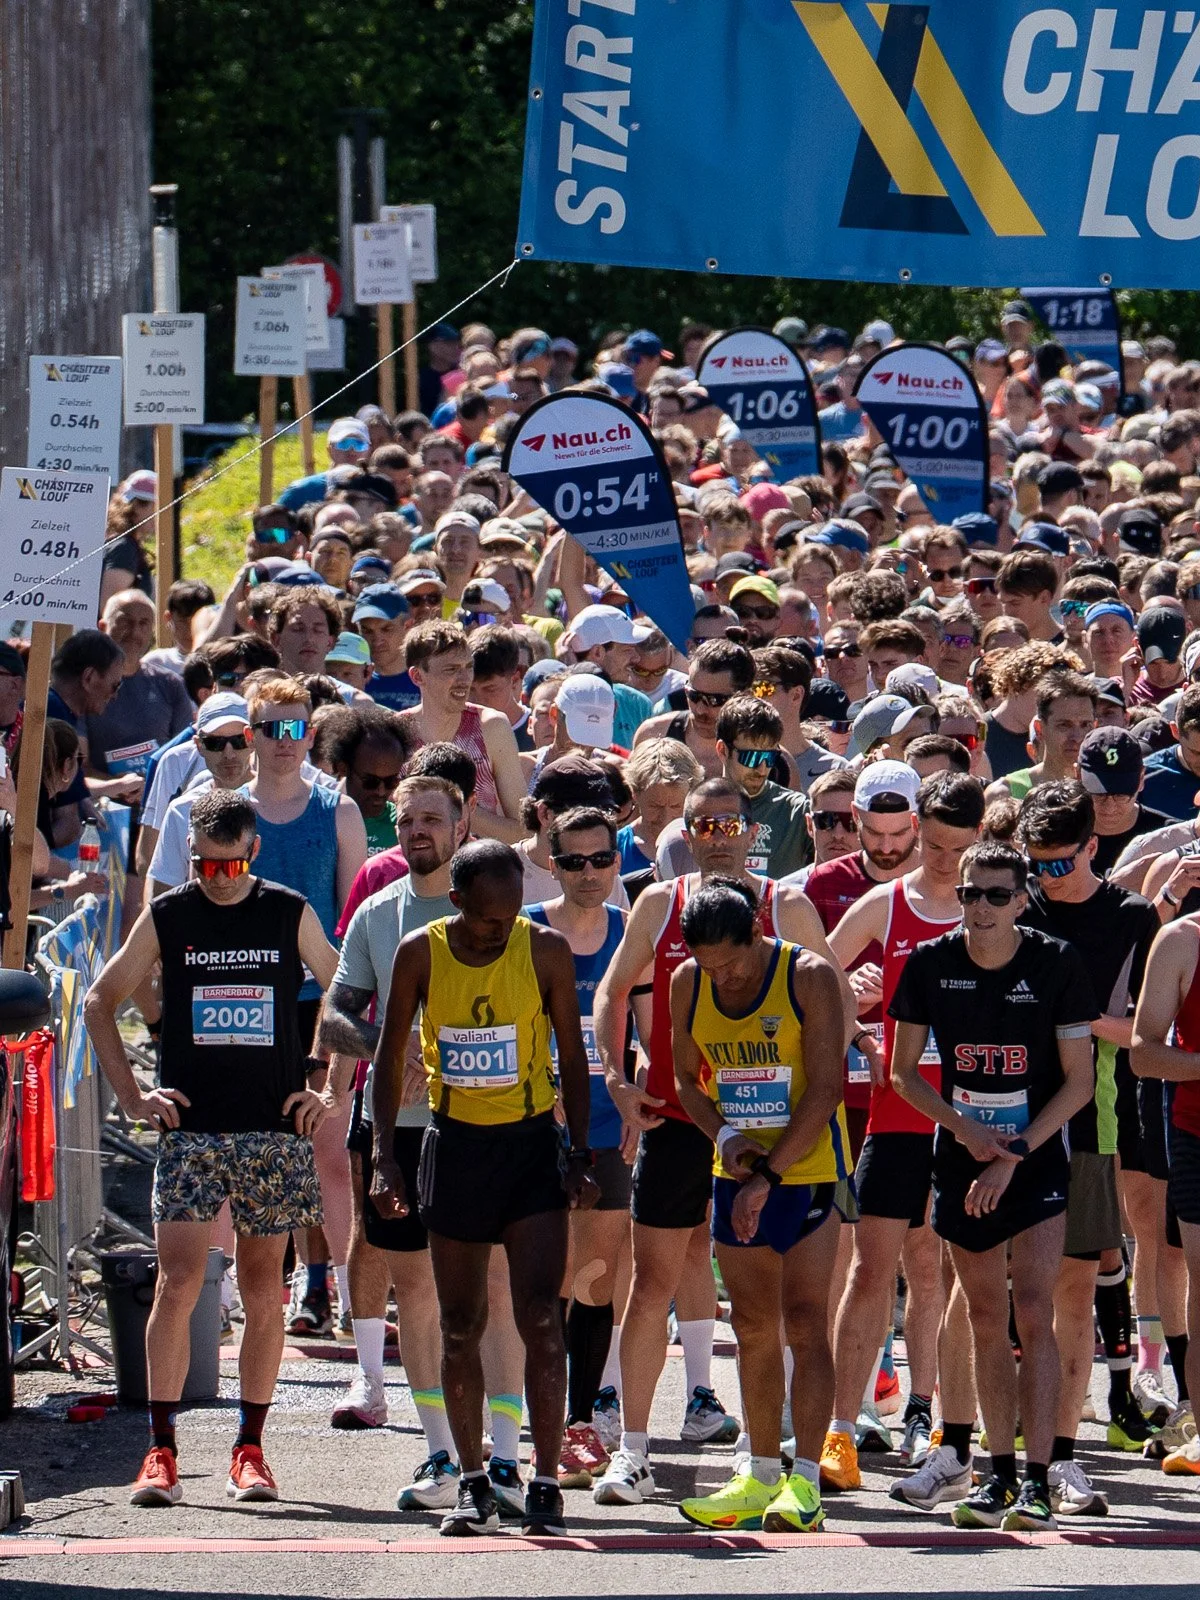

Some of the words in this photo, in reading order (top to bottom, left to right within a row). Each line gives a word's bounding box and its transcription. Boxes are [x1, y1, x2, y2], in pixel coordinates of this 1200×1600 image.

[732, 353, 788, 367] Nau.ch
[144, 363, 186, 376] 1.00h
[65, 374, 90, 383] LOUF
[898, 373, 963, 390] Nau.ch
[58, 398, 93, 407] Zielzeit
[134, 402, 164, 413] 5:00
[50, 413, 100, 430] 0.54h
[552, 423, 632, 450] Nau.ch
[45, 443, 103, 453] Durchschnitt
[555, 451, 576, 461] News
[577, 449, 589, 458] für
[589, 447, 601, 456] die
[36, 458, 72, 470] 4:30
[73, 462, 110, 473] min/km
[40, 491, 70, 502] LOUF
[31, 520, 70, 532] Zielzeit
[629, 528, 670, 542] MIN/KM
[20, 538, 80, 558] 0.48h
[13, 573, 81, 587] Durchschnitt
[3, 590, 45, 607] 4:00
[46, 599, 88, 611] min/km
[185, 949, 280, 965] HORIZONTE
[202, 1007, 263, 1028] 2002
[452, 1030, 498, 1042] valiant
[447, 1048, 505, 1071] 2001
[954, 1044, 1028, 1075] STB
[735, 1085, 758, 1098] 451
[26, 1091, 38, 1115] die
[721, 1101, 787, 1114] FERNANDO
[978, 1110, 995, 1121] 17
